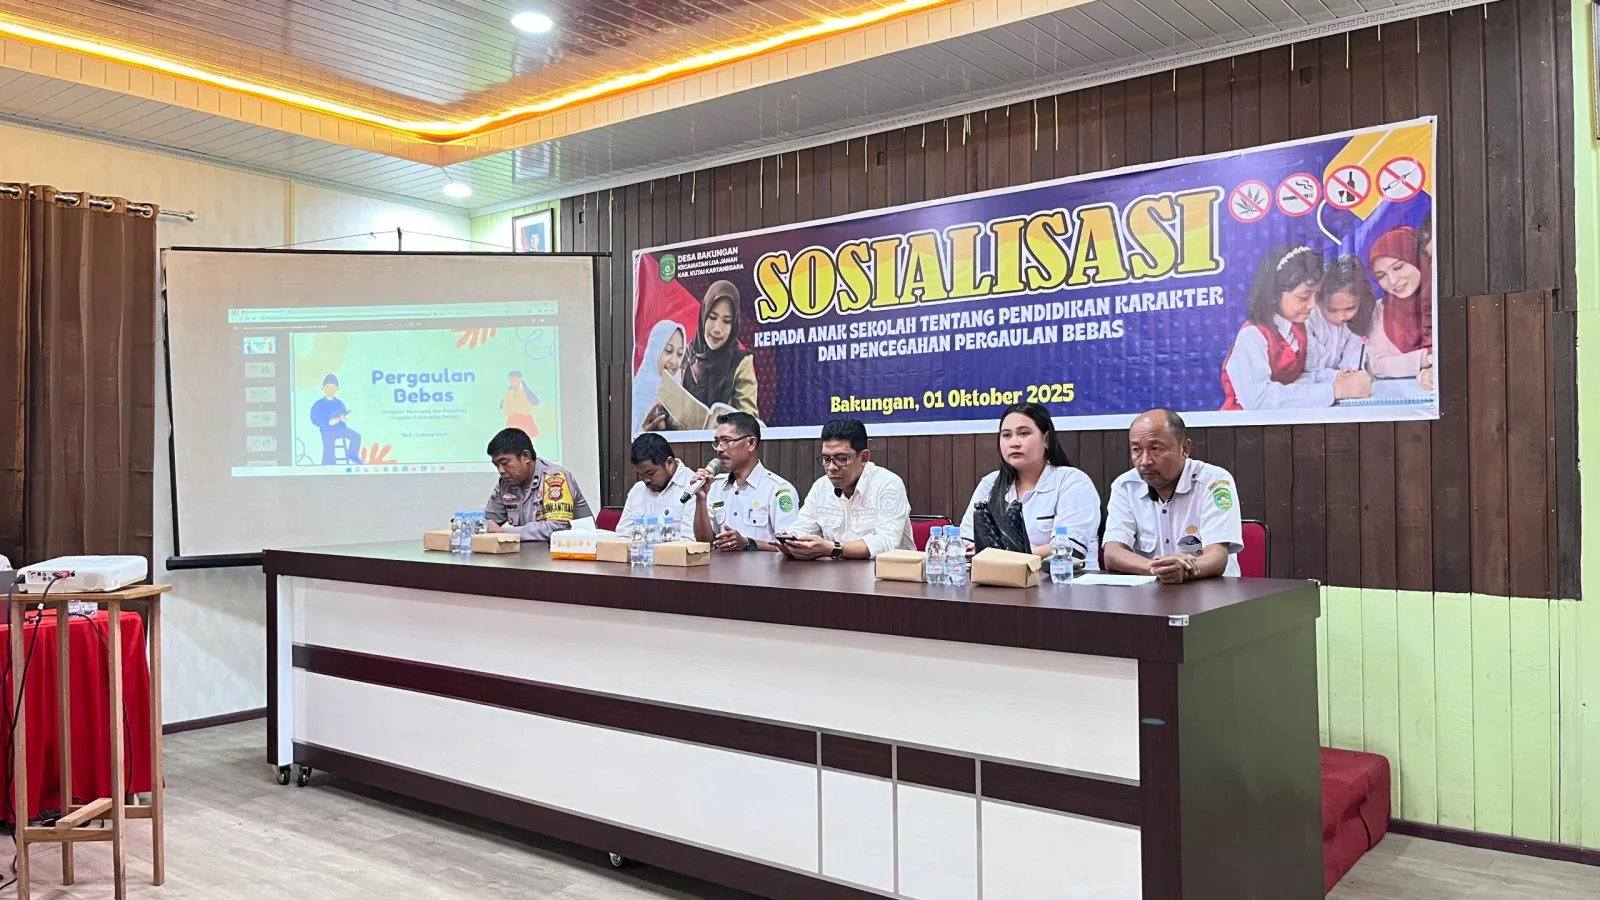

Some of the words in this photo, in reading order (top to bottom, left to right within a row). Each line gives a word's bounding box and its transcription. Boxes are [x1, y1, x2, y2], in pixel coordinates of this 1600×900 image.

[677, 253, 696, 263] DESA
[697, 246, 739, 260] BAKUNGAN
[677, 262, 709, 271] KECAMATAN
[709, 259, 720, 267] LOA
[719, 256, 738, 265] JANAN
[756, 188, 1223, 322] SOSIALISASI
[677, 271, 689, 279] KAB.
[689, 269, 705, 277] KUTAI
[705, 263, 744, 275] KARTANEGARA
[754, 327, 806, 348] KEPADA
[807, 324, 848, 343] ANAK
[850, 316, 917, 340] SEKOLAH
[920, 308, 995, 333] TENTANG
[998, 296, 1111, 326] PENDIDIKAN
[1115, 285, 1224, 315] KARAKTER
[818, 344, 847, 362] DAN
[850, 334, 951, 360] PENCEGAHAN
[954, 324, 1058, 351] PERGAULAN
[1062, 319, 1125, 342] BEBAS
[371, 367, 476, 388] Pergaulan
[393, 387, 454, 403] Bebas
[830, 395, 920, 415] Bakungan,
[923, 390, 945, 409] 01
[948, 387, 1023, 407] Oktober
[1026, 382, 1075, 404] 2025
